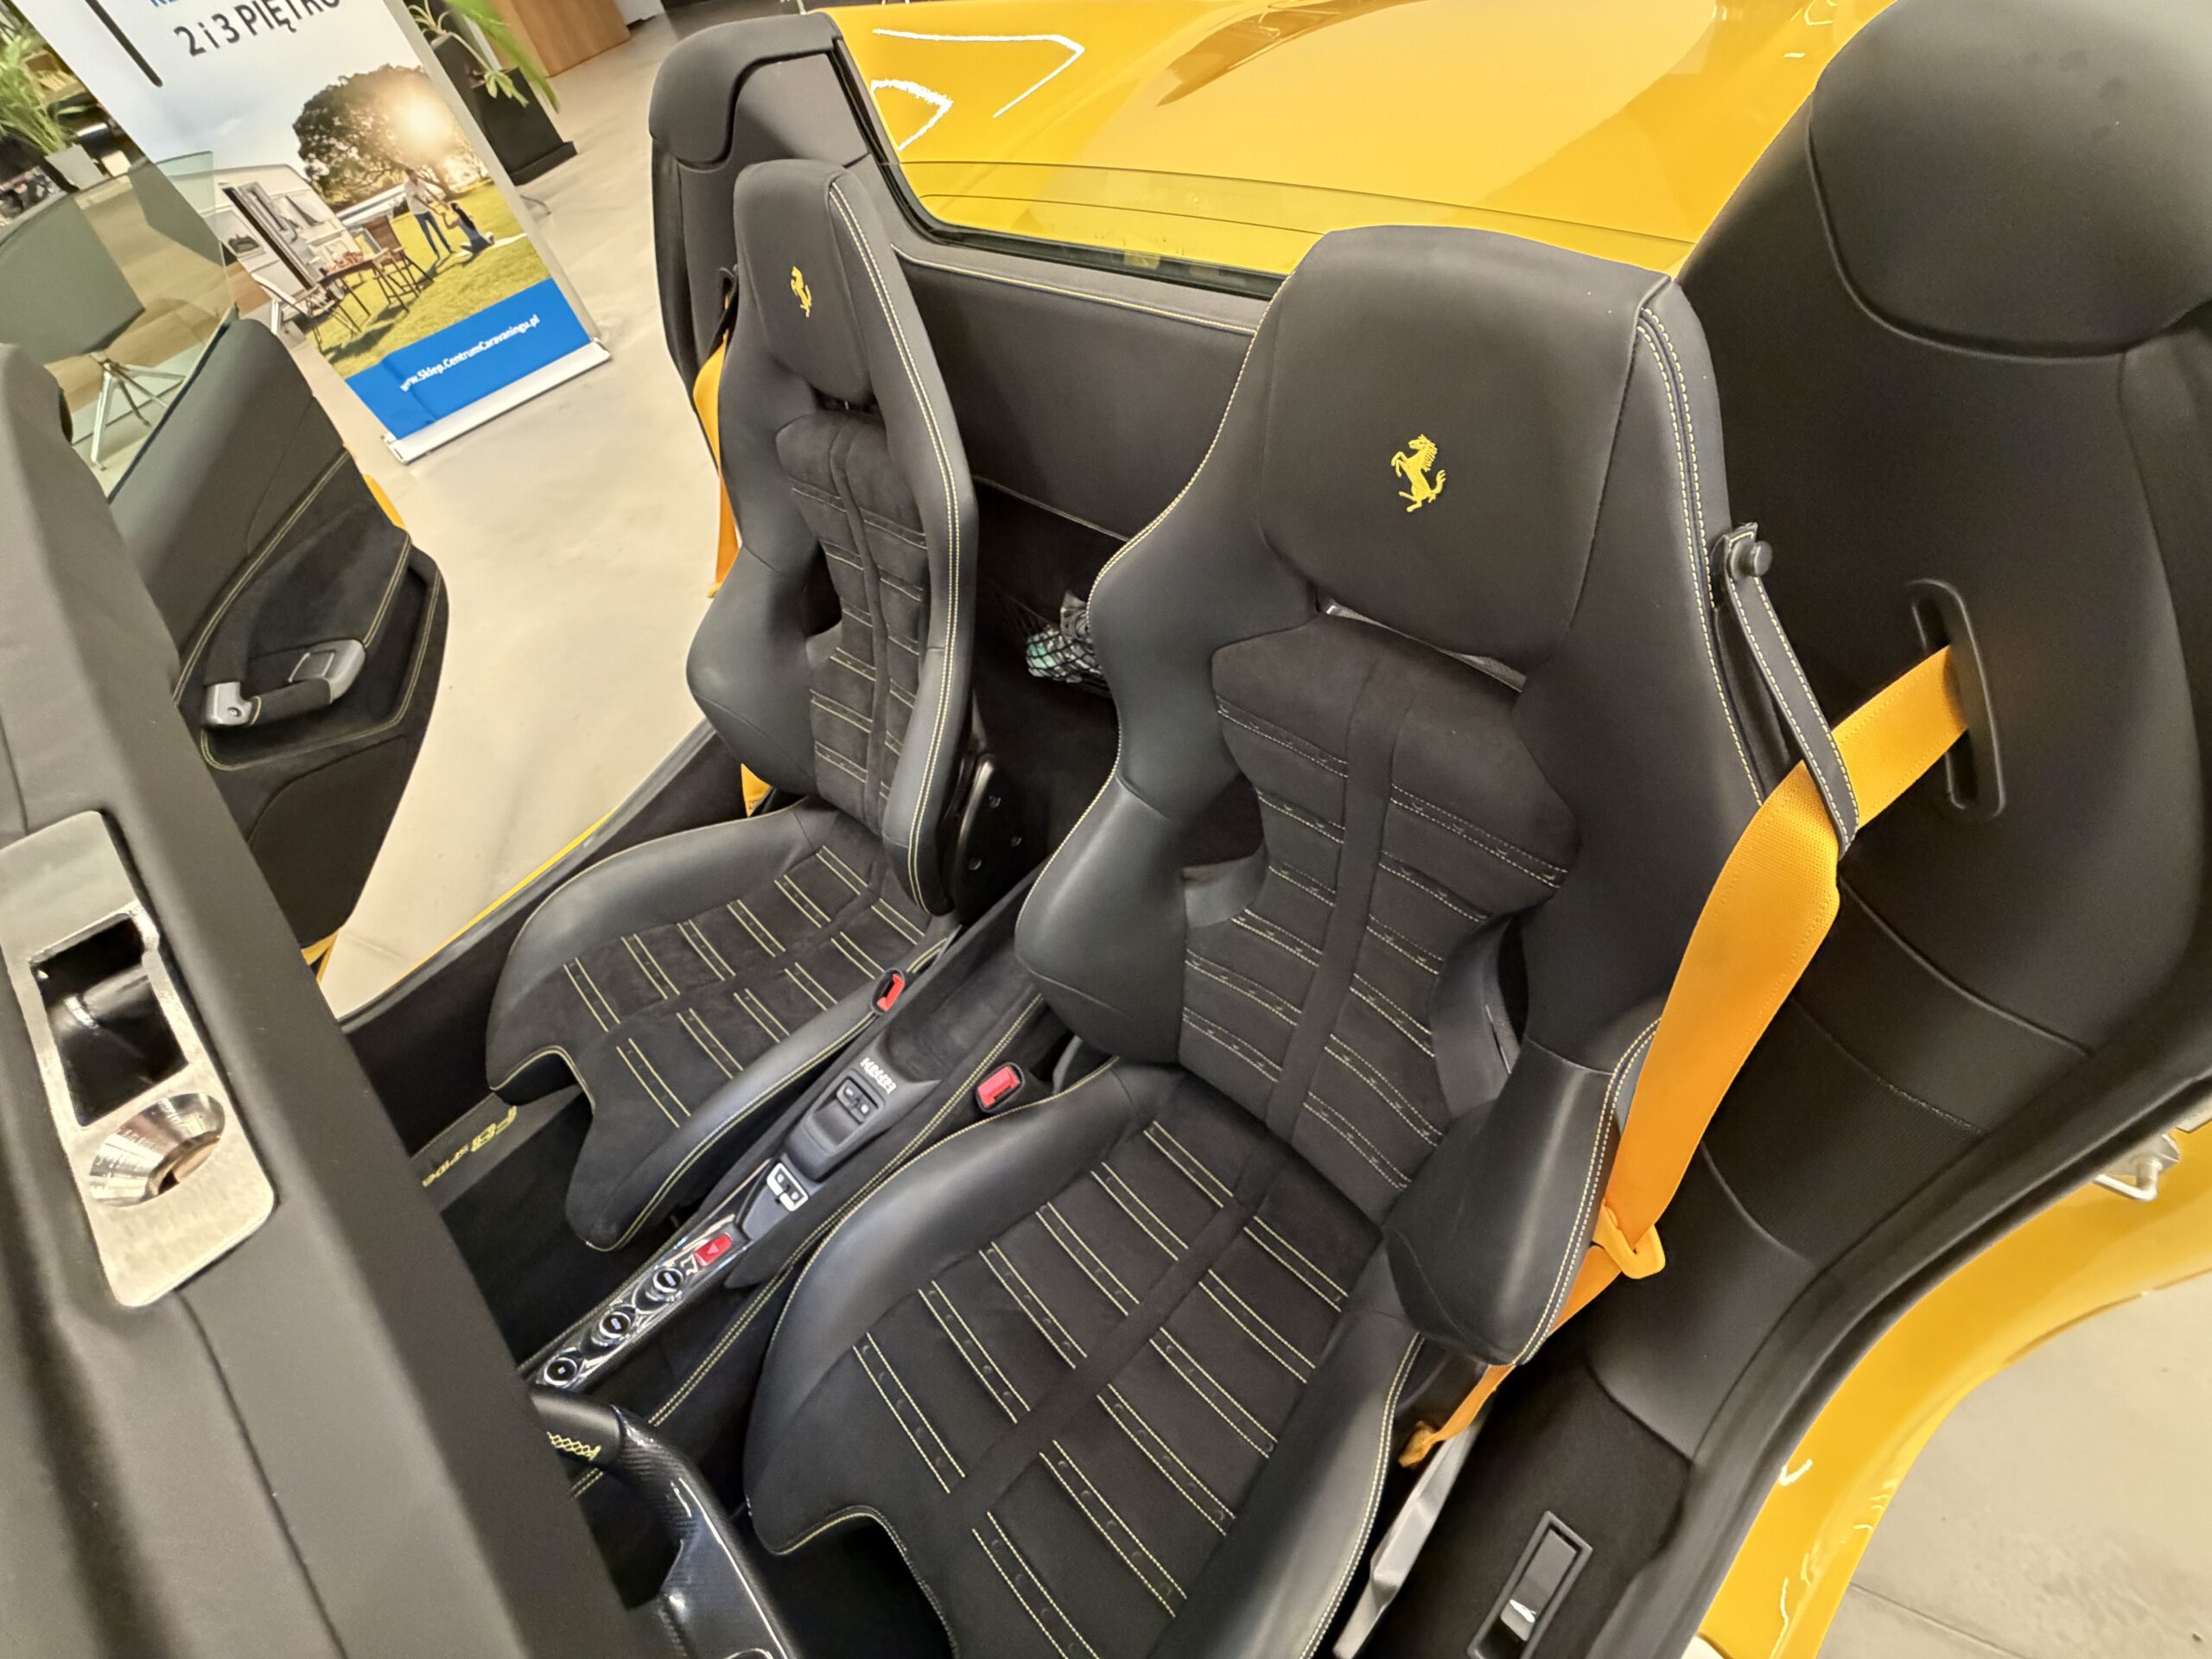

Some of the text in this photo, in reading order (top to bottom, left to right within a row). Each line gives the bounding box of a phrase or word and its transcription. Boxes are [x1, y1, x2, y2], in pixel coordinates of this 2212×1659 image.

[174, 0, 340, 57] 2 i 3 PIĘTR
